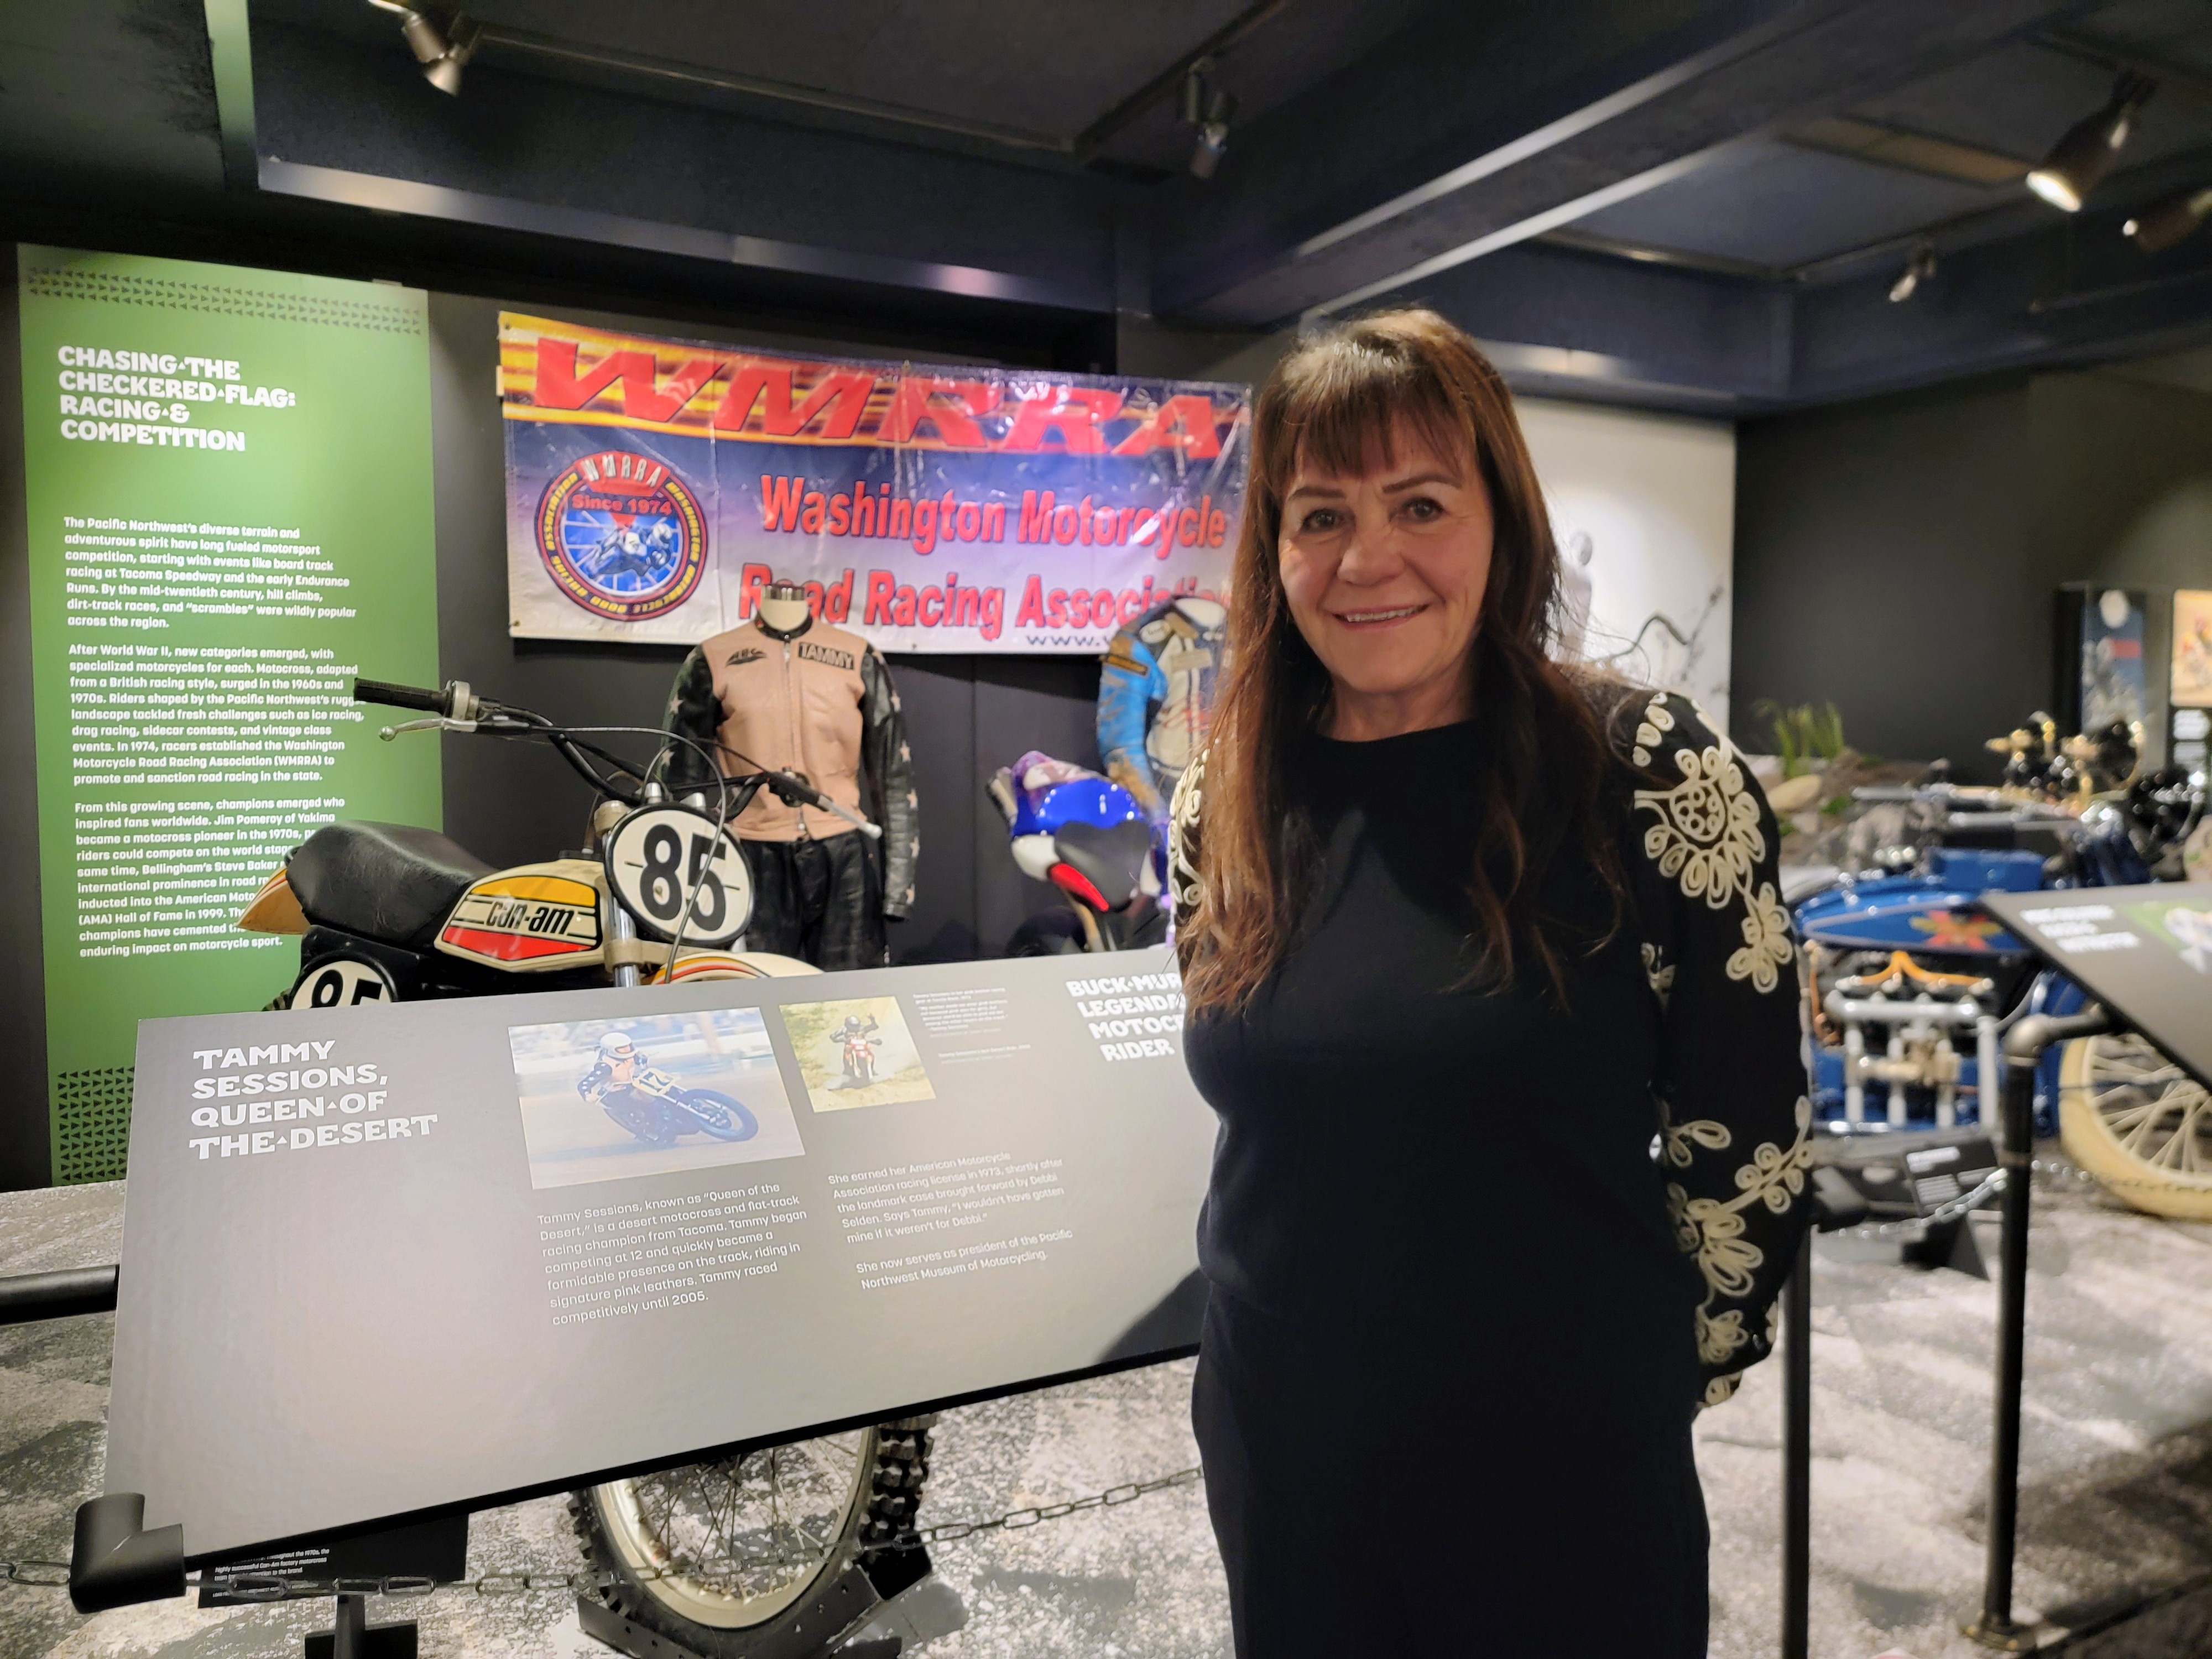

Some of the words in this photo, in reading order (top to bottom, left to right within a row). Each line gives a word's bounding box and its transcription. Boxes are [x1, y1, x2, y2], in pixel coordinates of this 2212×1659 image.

[58, 346, 178, 374] CHASING
[184, 357, 241, 380] THE
[59, 370, 216, 401] CHECKERED
[225, 384, 296, 408] FLAG:
[535, 338, 1221, 458] WMRRA
[60, 395, 160, 421] RACING
[170, 403, 190, 423] &
[61, 419, 245, 451] COMPETITION
[582, 454, 661, 487] WMRRA
[572, 494, 623, 511] Since
[628, 499, 672, 515] 1974
[760, 474, 1004, 554] Washington
[1018, 489, 1225, 559] Motorcycle
[64, 517, 85, 528] The
[87, 518, 127, 530] Pacific
[199, 523, 239, 536] diverse
[241, 526, 278, 538] terrain
[279, 528, 300, 539] and
[65, 533, 137, 546] adventurous
[139, 536, 169, 549] spirit
[171, 538, 198, 550] have
[200, 539, 224, 553] long
[226, 540, 260, 552] fueled
[262, 544, 320, 556] motorsport
[864, 568, 1005, 641] Racing
[69, 644, 98, 655] After
[100, 645, 133, 655] World
[135, 645, 158, 656] War
[161, 646, 172, 658] II,
[175, 648, 198, 656] new
[200, 646, 258, 660] categories
[260, 648, 308, 660] emerged,
[311, 648, 334, 659] with
[800, 642, 853, 669] TAMMY
[72, 742, 114, 752] events.
[117, 742, 128, 752] In
[131, 742, 159, 752] 1974,
[161, 743, 197, 751] racers
[199, 740, 262, 751] established
[264, 740, 282, 750] the
[284, 739, 345, 752] Washington
[75, 803, 103, 813] From
[106, 801, 128, 812] this
[130, 801, 175, 814] growing
[178, 802, 213, 811] scene,
[216, 799, 275, 811] champions
[276, 797, 321, 810] emerged
[324, 797, 345, 807] who
[76, 817, 122, 831] inspired
[124, 817, 149, 828] fans
[152, 815, 212, 827] worldwide.
[214, 815, 234, 825] Jim
[237, 815, 283, 826] Pomeroy
[285, 813, 296, 823] of
[298, 812, 335, 823] Yakima
[640, 823, 727, 932] 85
[80, 945, 129, 957] enduring
[133, 943, 171, 955] impact
[173, 943, 187, 952] on
[190, 938, 249, 951] motorcycle
[252, 936, 283, 948] sport.
[1066, 977, 1130, 997] BUCK
[193, 1040, 336, 1070] TAMMY
[1100, 1039, 1175, 1061] RIDER
[191, 1063, 388, 1099] SESSIONS,
[191, 1096, 324, 1128] QUEEN
[340, 1091, 387, 1114] OF
[189, 1130, 275, 1160] THE
[290, 1114, 437, 1150] DESERT
[537, 1212, 580, 1224] Tammy
[584, 1204, 641, 1217] Sessions,
[645, 1198, 684, 1210] known
[687, 1195, 701, 1203] as
[748, 1185, 758, 1195] of
[761, 1183, 779, 1193] the
[594, 1223, 604, 1233] is
[618, 1216, 657, 1229] desert
[660, 1208, 721, 1223] motocross
[724, 1202, 745, 1214] and
[748, 1195, 799, 1211] flat-track
[542, 1244, 581, 1256] racing
[585, 1234, 645, 1250] champion
[648, 1230, 675, 1241] from
[677, 1223, 727, 1237] Tacoma.
[728, 1216, 768, 1229] Tammy
[771, 1211, 806, 1223] began
[545, 1256, 611, 1272] competing
[615, 1253, 627, 1262] at
[630, 1250, 642, 1260] 12
[646, 1245, 668, 1258] and
[672, 1239, 713, 1255] quickly
[716, 1233, 763, 1247] became
[547, 1271, 614, 1290] formidable
[618, 1263, 675, 1281] presence
[678, 1260, 693, 1269] on
[696, 1256, 715, 1266] the
[718, 1250, 752, 1263] track,
[754, 1245, 787, 1258] riding
[789, 1242, 800, 1252] in
[856, 1262, 878, 1273] She
[880, 1258, 902, 1269] now
[905, 1252, 941, 1265] serves
[943, 1250, 957, 1258] as
[958, 1240, 1006, 1258] president
[1008, 1237, 1018, 1247] of
[1020, 1235, 1037, 1245] the
[1039, 1229, 1072, 1241] Pacific
[550, 1291, 610, 1307] signature
[614, 1284, 640, 1300] pink
[643, 1277, 697, 1292] leathers.
[698, 1269, 740, 1283] Tammy
[744, 1261, 777, 1276] raced
[861, 1271, 919, 1289] Northwest
[920, 1264, 966, 1279] Museum
[967, 1259, 978, 1270] of
[979, 1250, 1046, 1267] Motorcycling.
[552, 1302, 638, 1324] competitively
[642, 1296, 669, 1310] until
[672, 1290, 708, 1305] 2005.
[231, 1563, 259, 1572] successful
